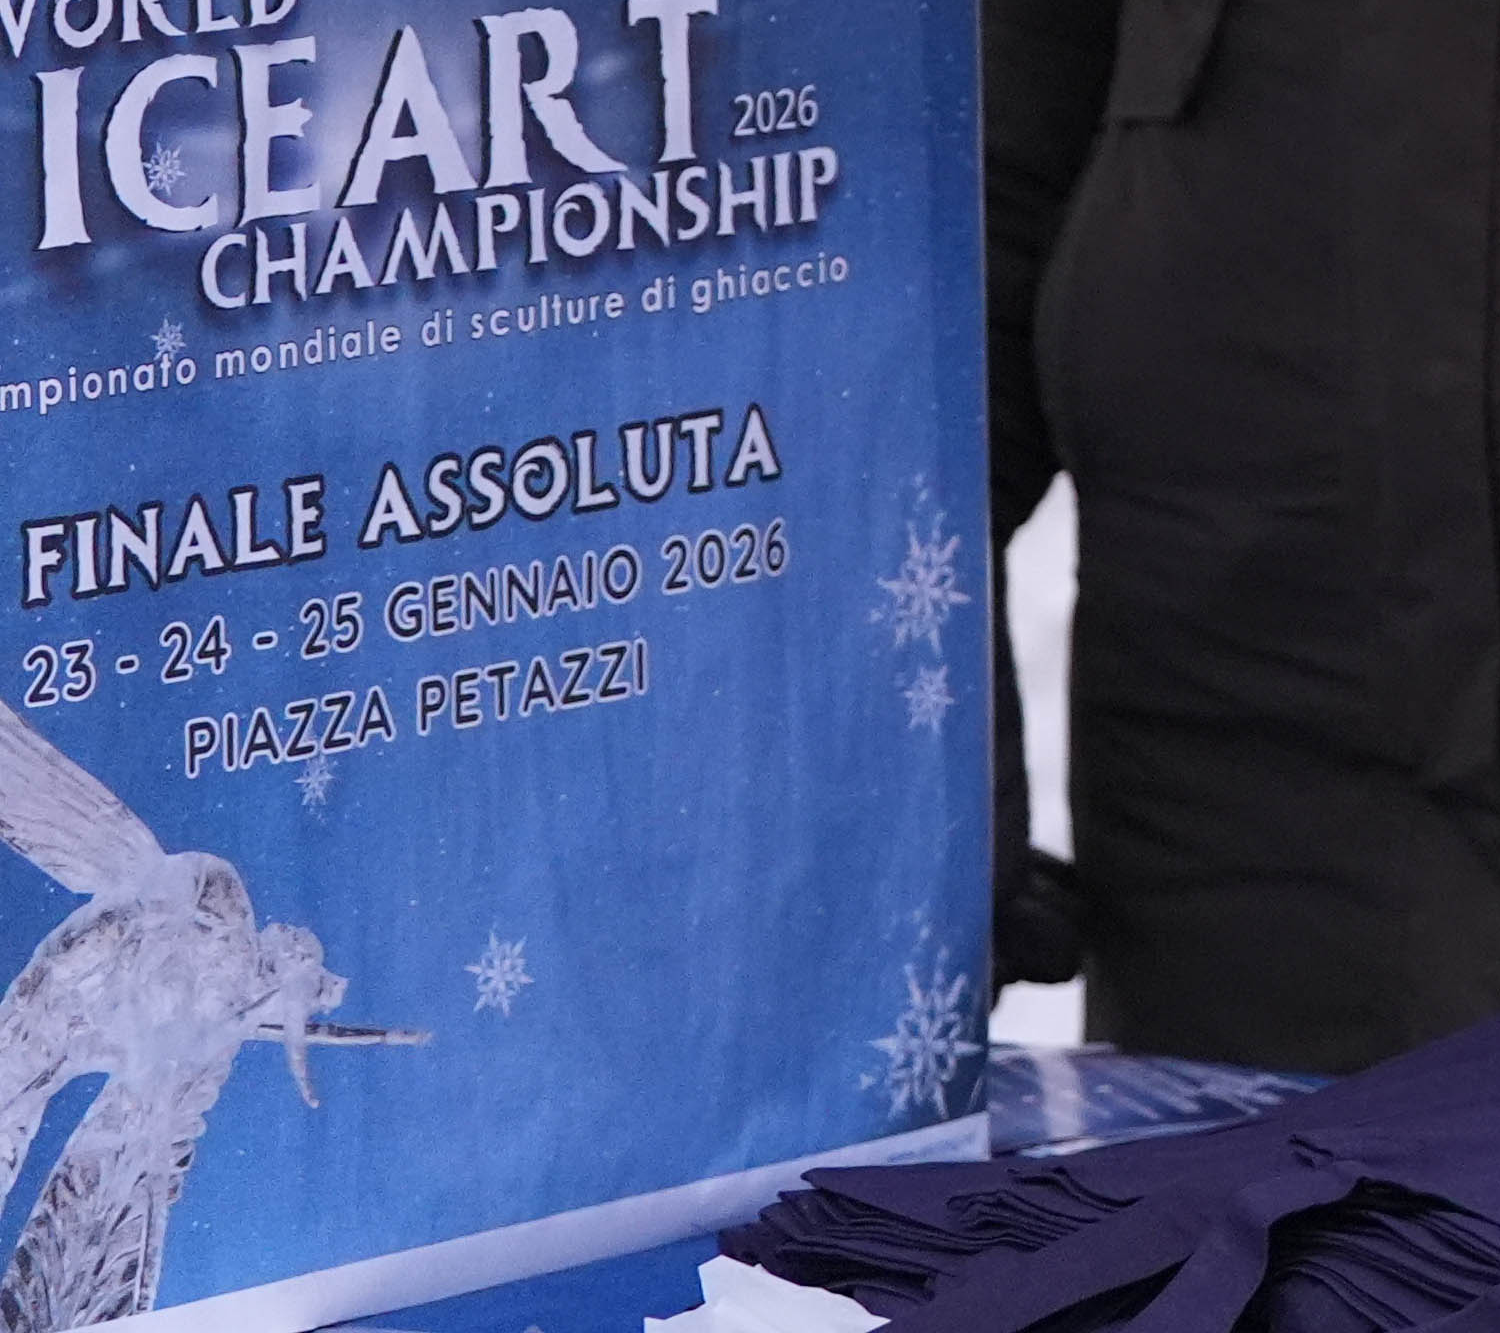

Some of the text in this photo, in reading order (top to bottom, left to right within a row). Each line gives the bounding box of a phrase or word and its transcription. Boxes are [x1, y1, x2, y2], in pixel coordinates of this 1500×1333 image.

[733, 84, 819, 137] 2026
[200, 145, 839, 311] CHAMPIONSHIP
[215, 314, 401, 380] mondiale
[421, 308, 454, 346] di
[470, 292, 624, 340] sculture
[641, 275, 676, 314] di
[692, 253, 849, 313] ghiaccio
[24, 406, 780, 603] FINALE ASSOLUTA
[25, 640, 94, 707] 23
[161, 621, 229, 683] 24
[301, 596, 363, 659] 25
[387, 548, 640, 642] GENNAIO
[662, 522, 789, 593] 2026
[186, 639, 650, 777] PIAZZA PETAZZI
